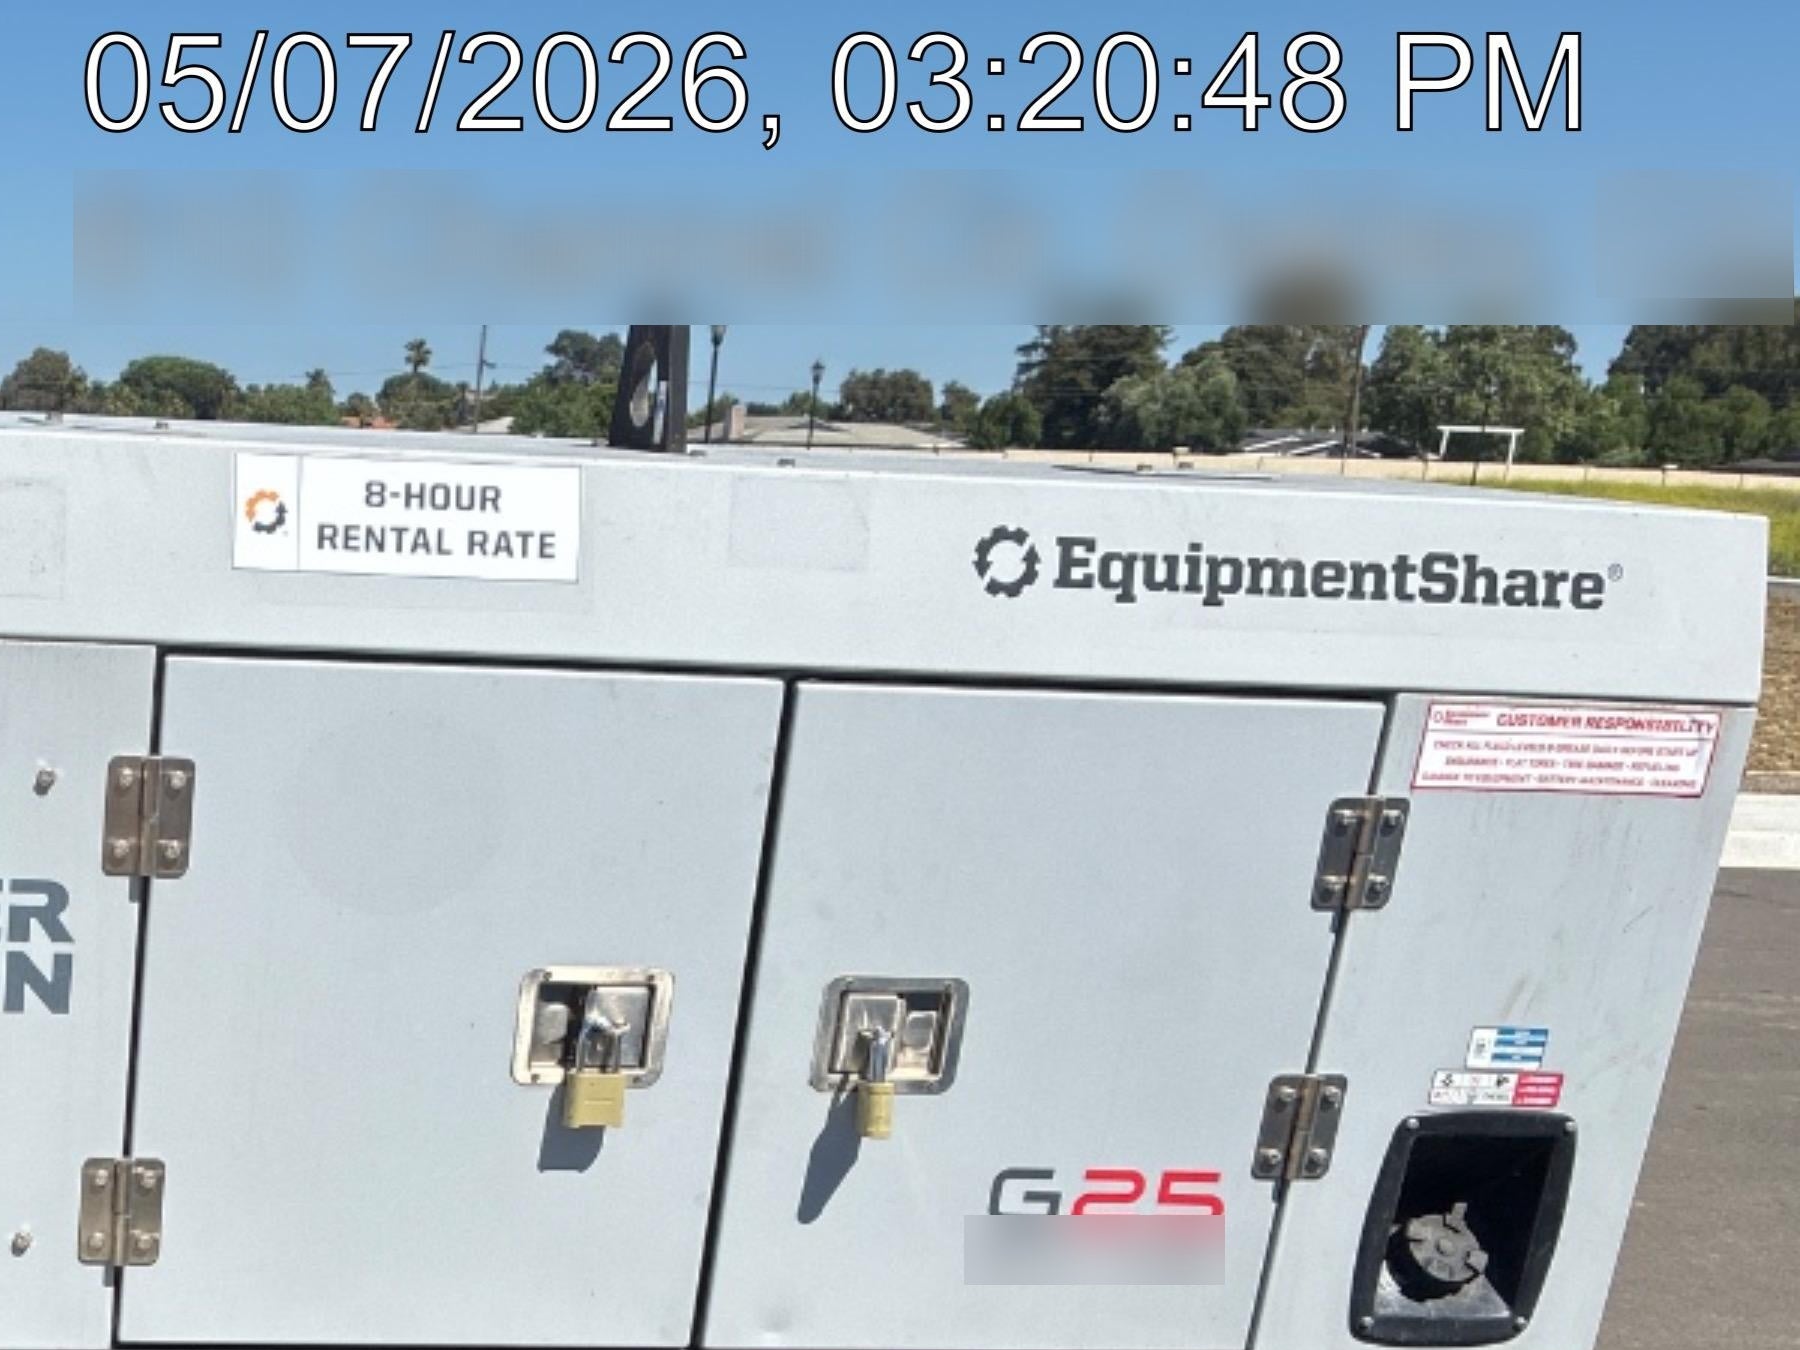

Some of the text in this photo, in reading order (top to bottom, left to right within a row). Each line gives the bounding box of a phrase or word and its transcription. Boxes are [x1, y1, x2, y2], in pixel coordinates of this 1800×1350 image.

[364, 480, 502, 513] 8-HOUR
[316, 523, 556, 560] RENTAL RATE
[988, 1167, 1225, 1216] G25
